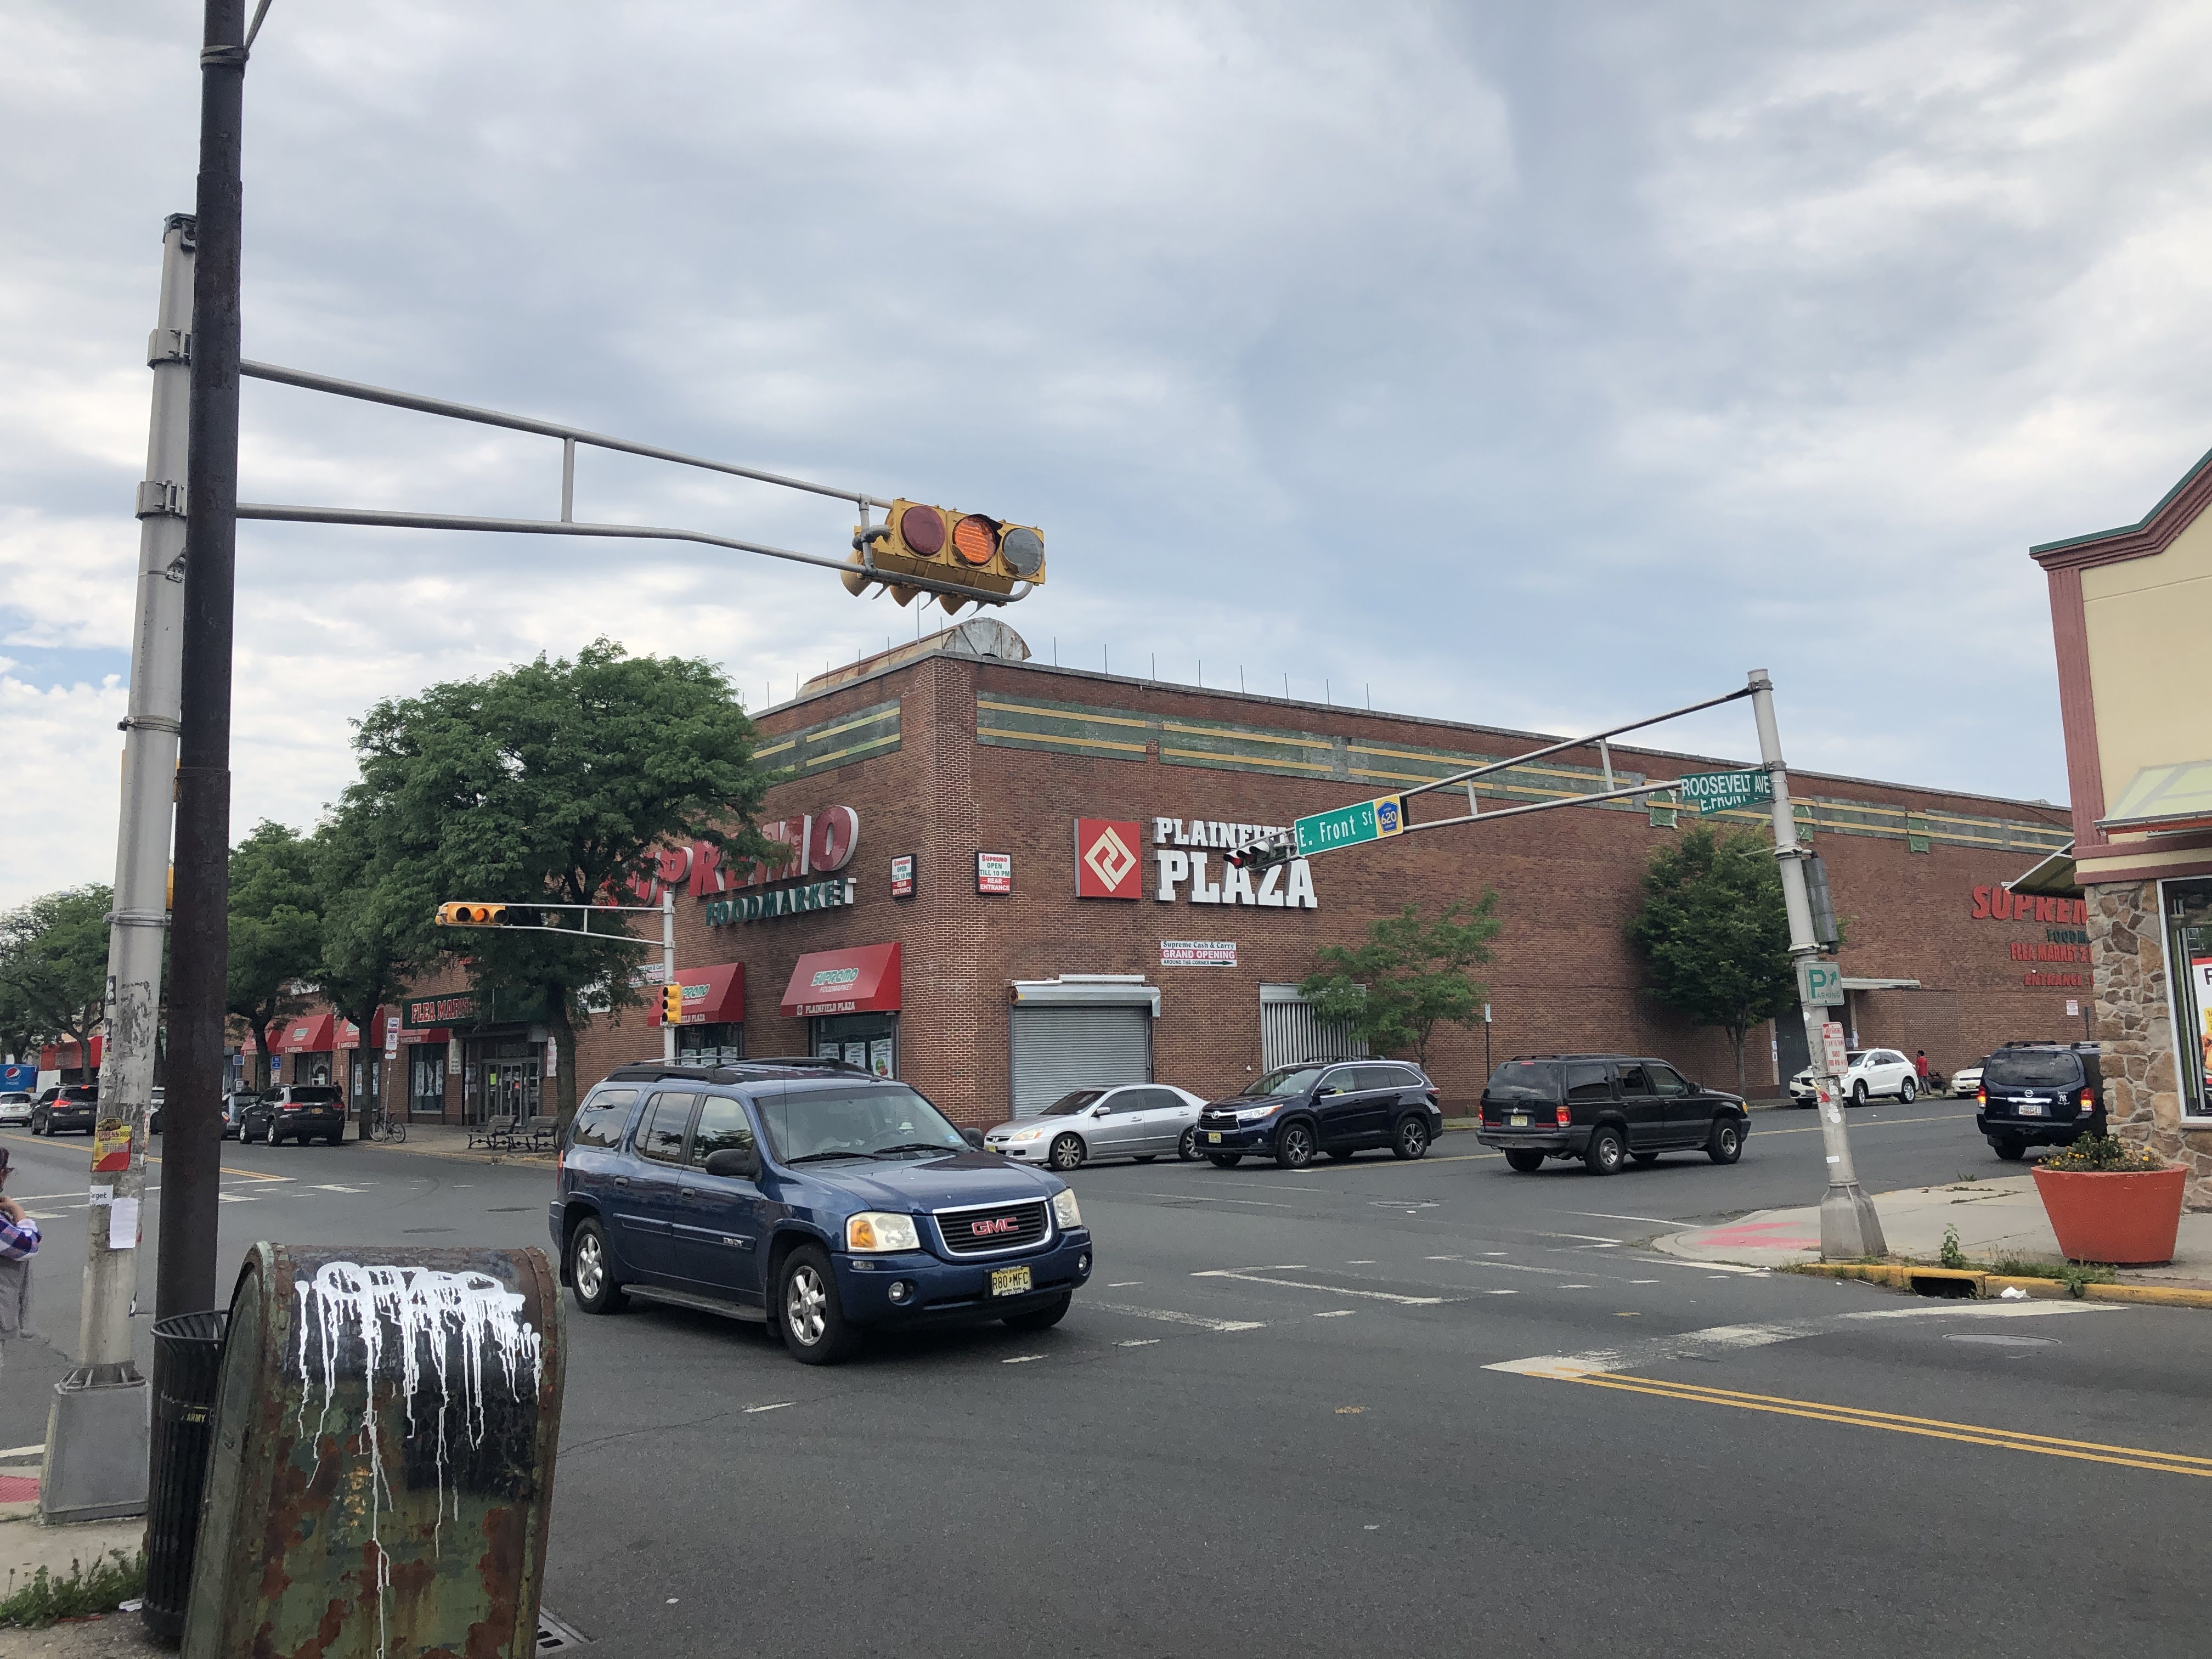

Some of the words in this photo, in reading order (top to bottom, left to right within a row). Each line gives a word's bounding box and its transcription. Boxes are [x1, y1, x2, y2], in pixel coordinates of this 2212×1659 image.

[1681, 775, 1750, 796] ROOSEVELT
[1755, 775, 1770, 793] AVE
[1381, 810, 1397, 825] 620
[1154, 816, 1296, 849] PLAINFIEL
[1299, 827, 1313, 847] E.
[1319, 815, 1356, 842] Front
[1362, 810, 1373, 826] St
[981, 854, 1008, 862] SUPREMO
[1155, 849, 1318, 908] PLAZA
[706, 878, 856, 926] FOODMARKET
[1163, 950, 1194, 958] GRAND
[1196, 950, 1235, 959] OPENING
[1217, 942, 1234, 950] Carry
[2010, 943, 2035, 961] FLEA
[2037, 944, 2077, 962] MARKET
[811, 968, 859, 986] SUPREMO
[2024, 973, 2082, 986] ENTRANCE
[820, 984, 854, 993] FOODMARKET
[411, 1002, 436, 1023] FLEA
[805, 1003, 837, 1014] PLAINFIELD
[838, 1001, 855, 1011] PLAZA
[972, 1217, 1019, 1235] GMC
[992, 1275, 1008, 1290] R80
[1013, 1271, 1029, 1286] MFC
[187, 1413, 206, 1424] ARMY
